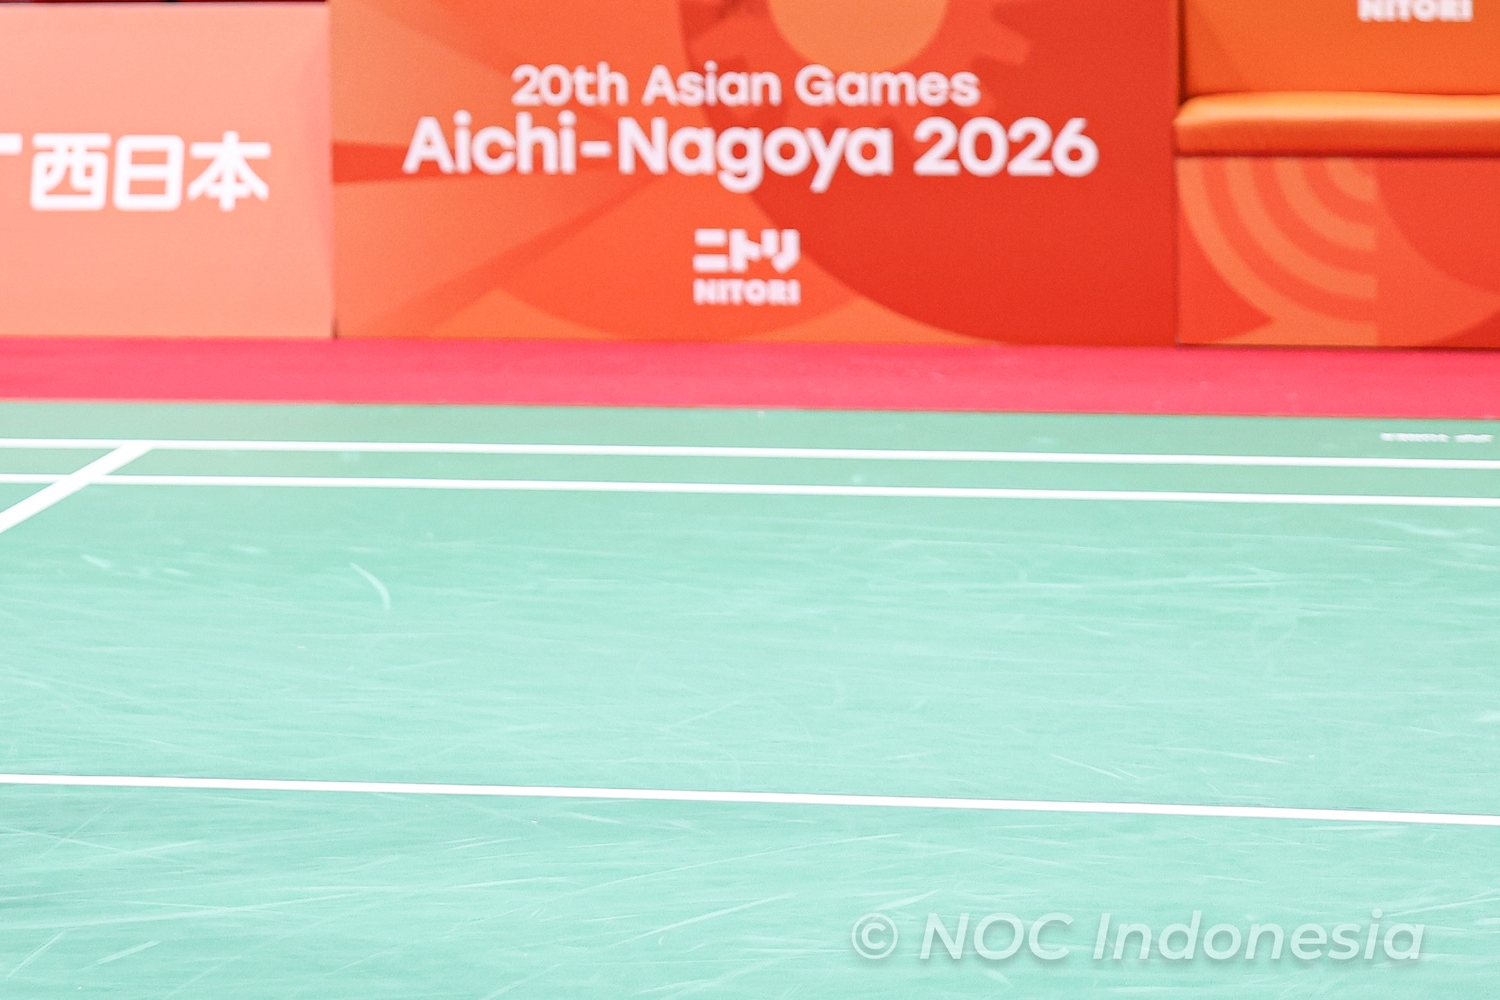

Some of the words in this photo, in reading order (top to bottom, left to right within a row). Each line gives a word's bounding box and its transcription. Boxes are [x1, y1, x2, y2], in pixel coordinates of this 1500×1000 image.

[512, 63, 627, 106] 20th
[642, 62, 781, 106] Asian
[795, 63, 980, 106] Games
[403, 111, 894, 194] Aichi-Nagoya
[913, 116, 1099, 177] 2026
[692, 227, 801, 274] ニトリ
[692, 278, 801, 306] NITORI
